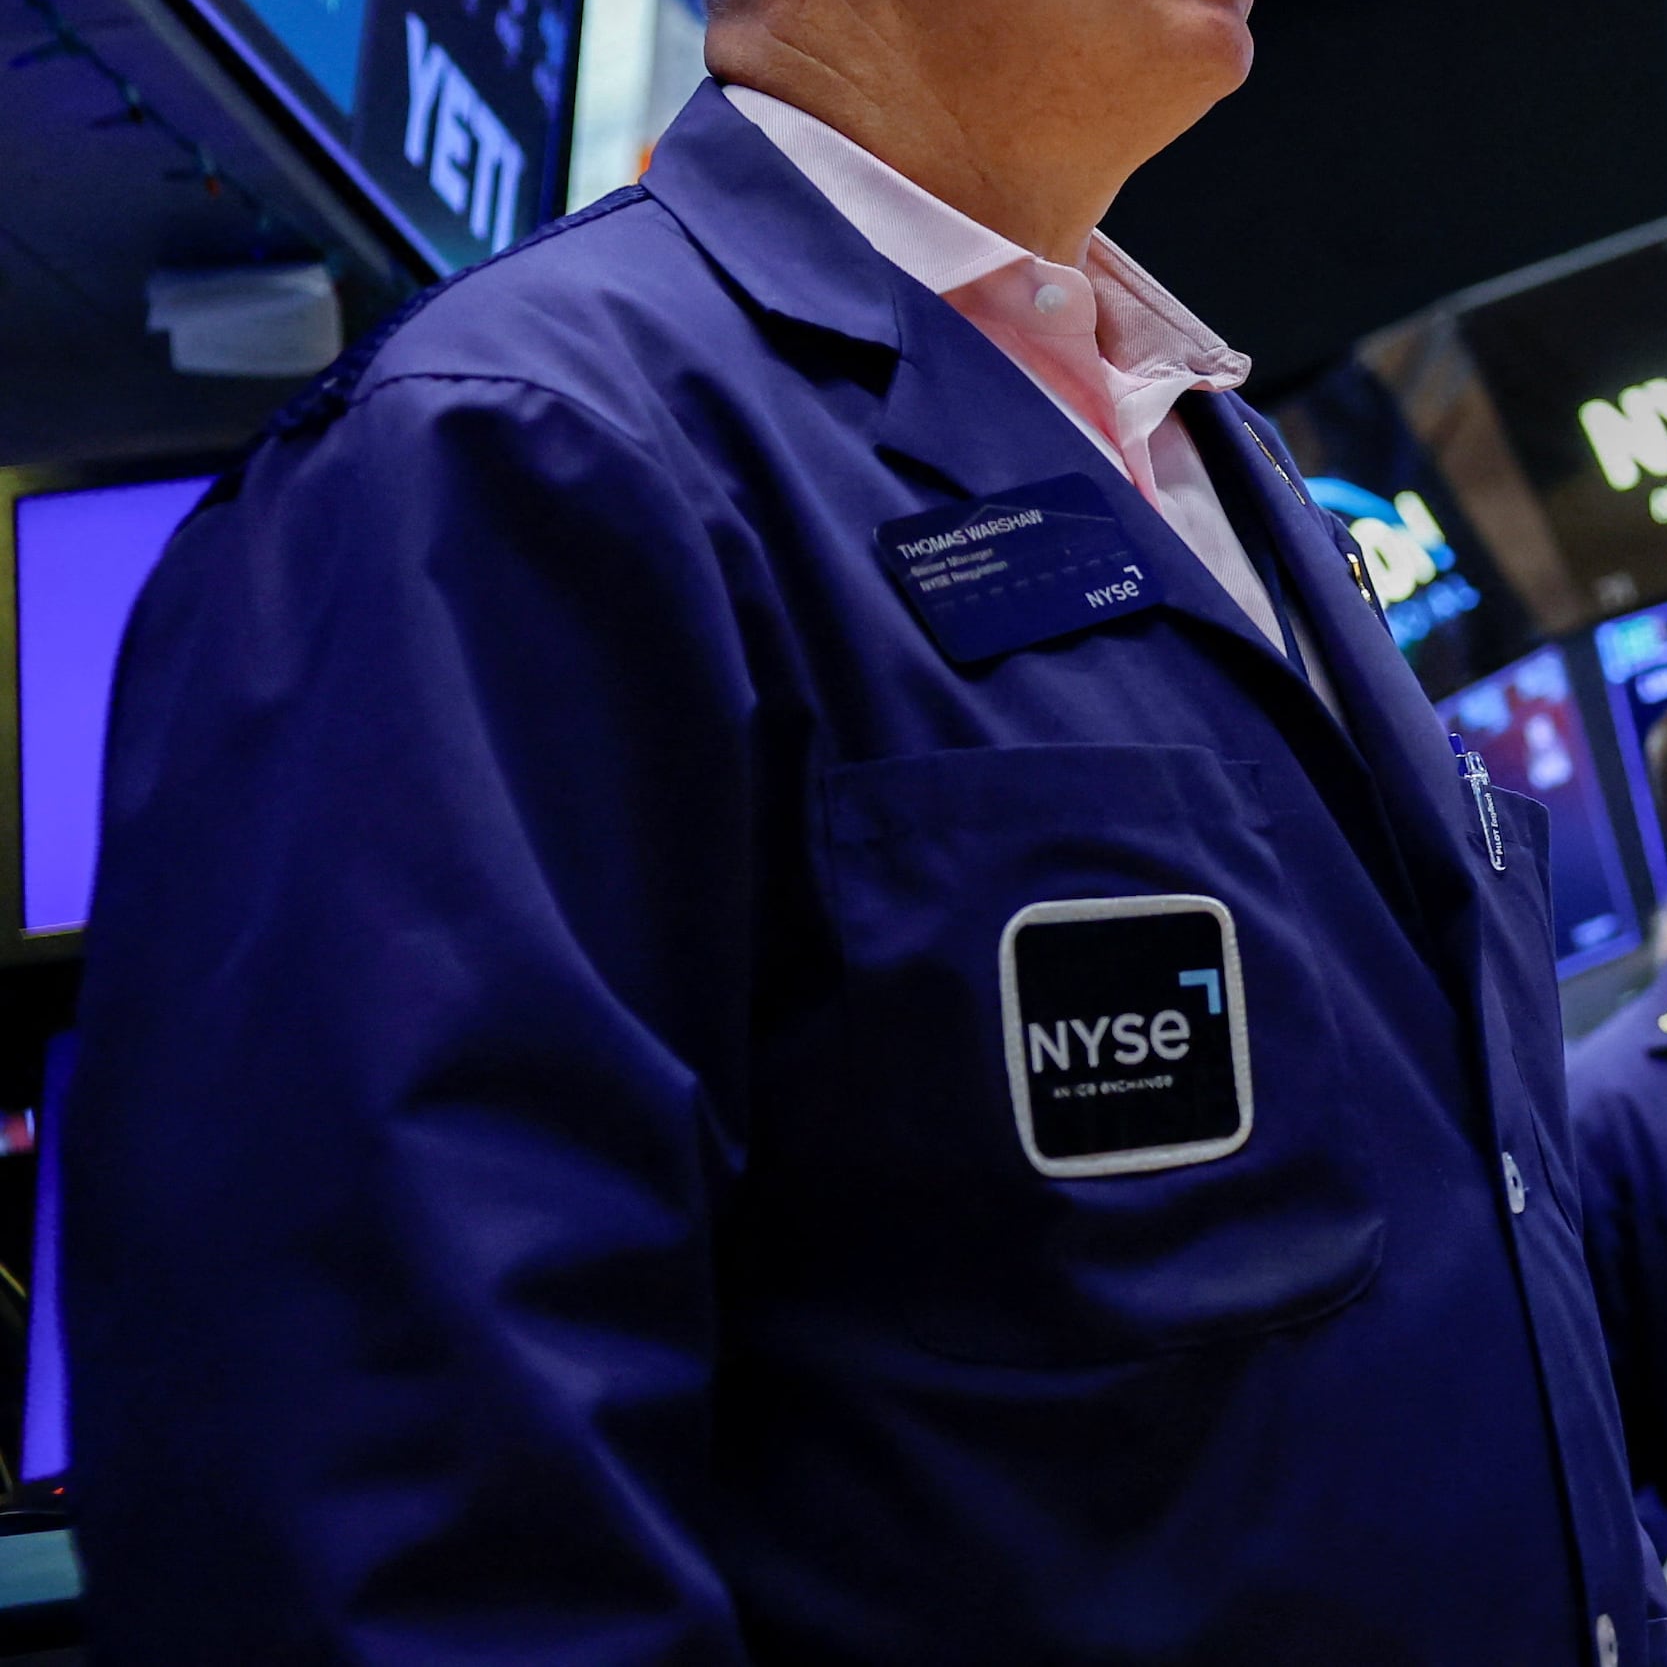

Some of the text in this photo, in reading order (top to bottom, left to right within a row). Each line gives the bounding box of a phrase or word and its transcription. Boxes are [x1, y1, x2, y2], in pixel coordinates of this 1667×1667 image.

[404, 12, 525, 254] YETI
[897, 509, 1044, 559] THOMAS WARSHAW
[947, 547, 994, 569] Manager
[1492, 829, 1504, 855] PILOT
